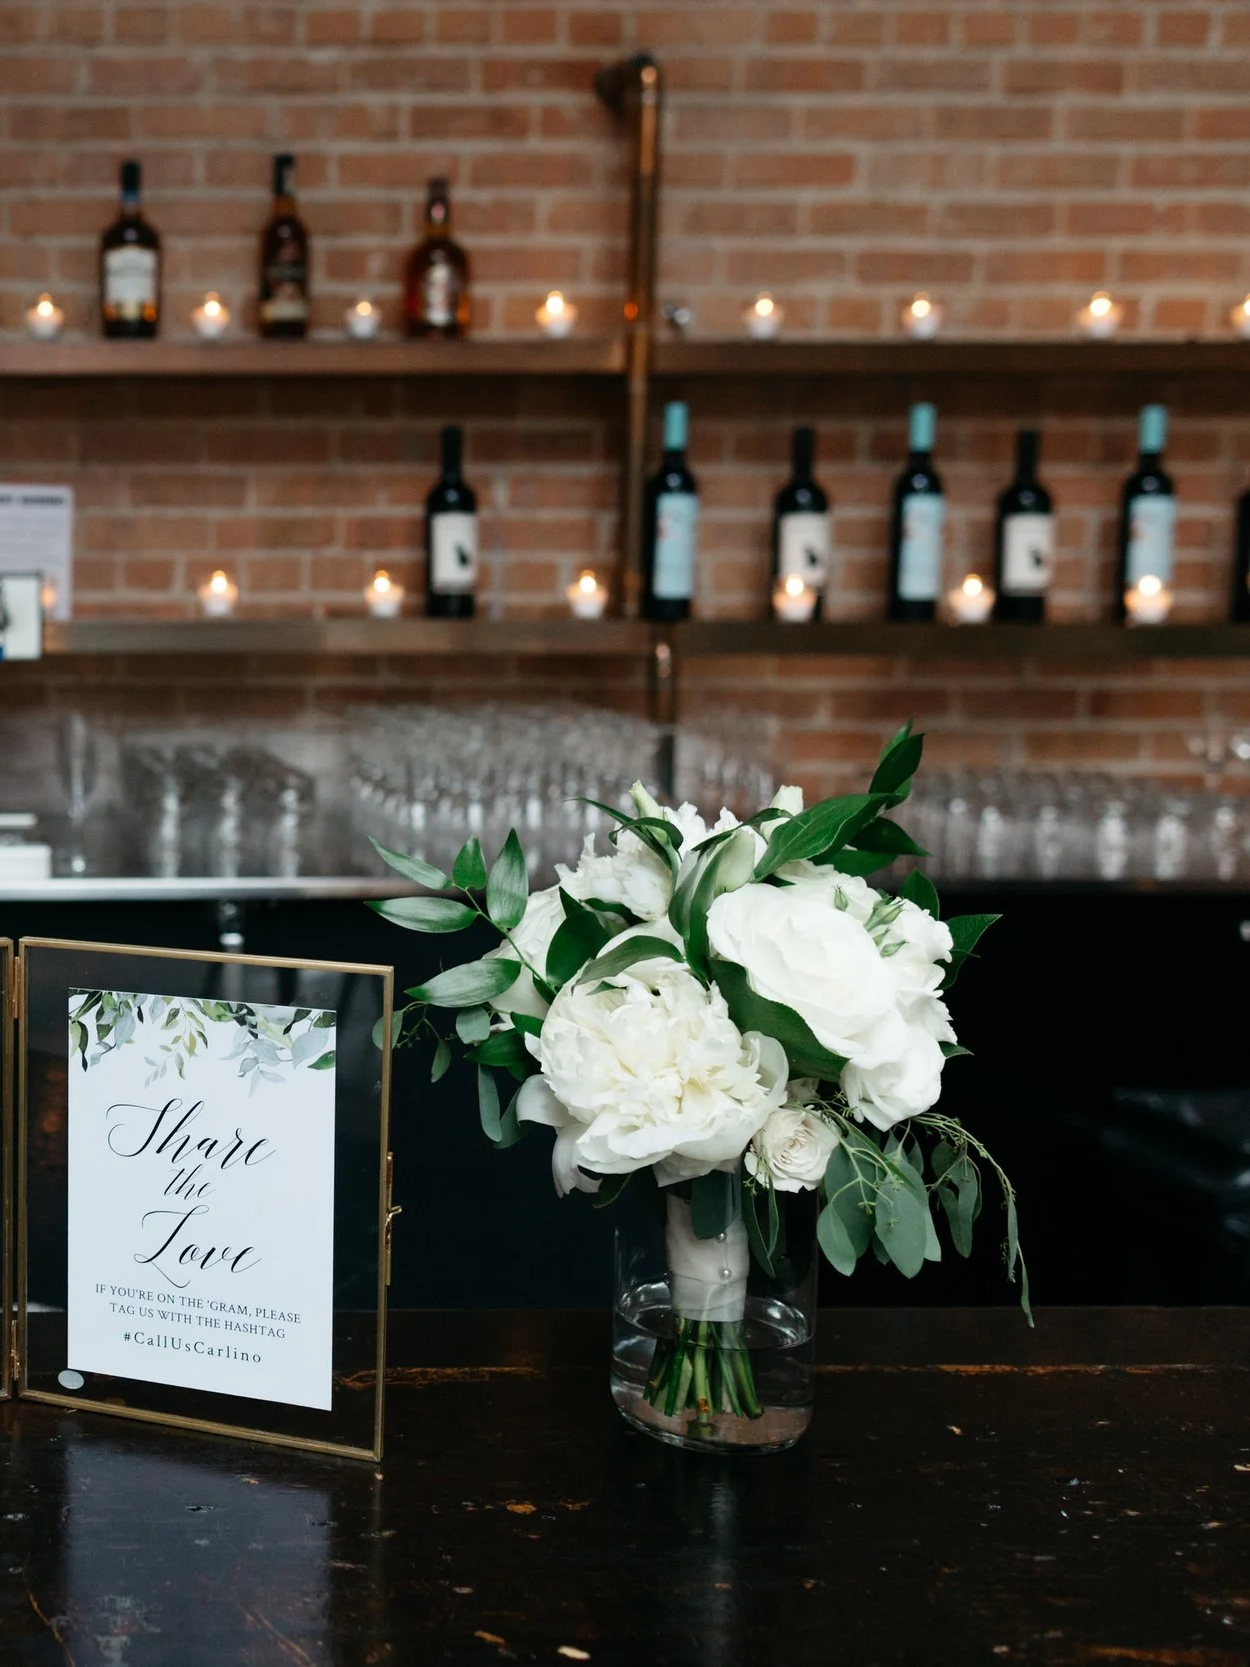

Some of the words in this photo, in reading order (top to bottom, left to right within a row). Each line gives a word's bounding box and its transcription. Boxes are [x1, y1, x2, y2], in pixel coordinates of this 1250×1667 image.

[106, 1098, 277, 1169] Share
[164, 1164, 215, 1200] the
[133, 1205, 262, 1288] Love
[96, 1284, 106, 1294] IF
[110, 1286, 154, 1301] YOU'RE
[157, 1293, 175, 1304] ON
[179, 1296, 203, 1309] THE
[207, 1300, 251, 1317] 'GRAM,
[256, 1308, 301, 1324] PLEASE
[110, 1303, 135, 1315] TAG
[139, 1307, 154, 1318] US
[158, 1310, 192, 1324] WITH
[196, 1316, 221, 1328] THE
[224, 1321, 286, 1338] HASHTAG
[124, 1332, 261, 1363] #CallUsCarlino
